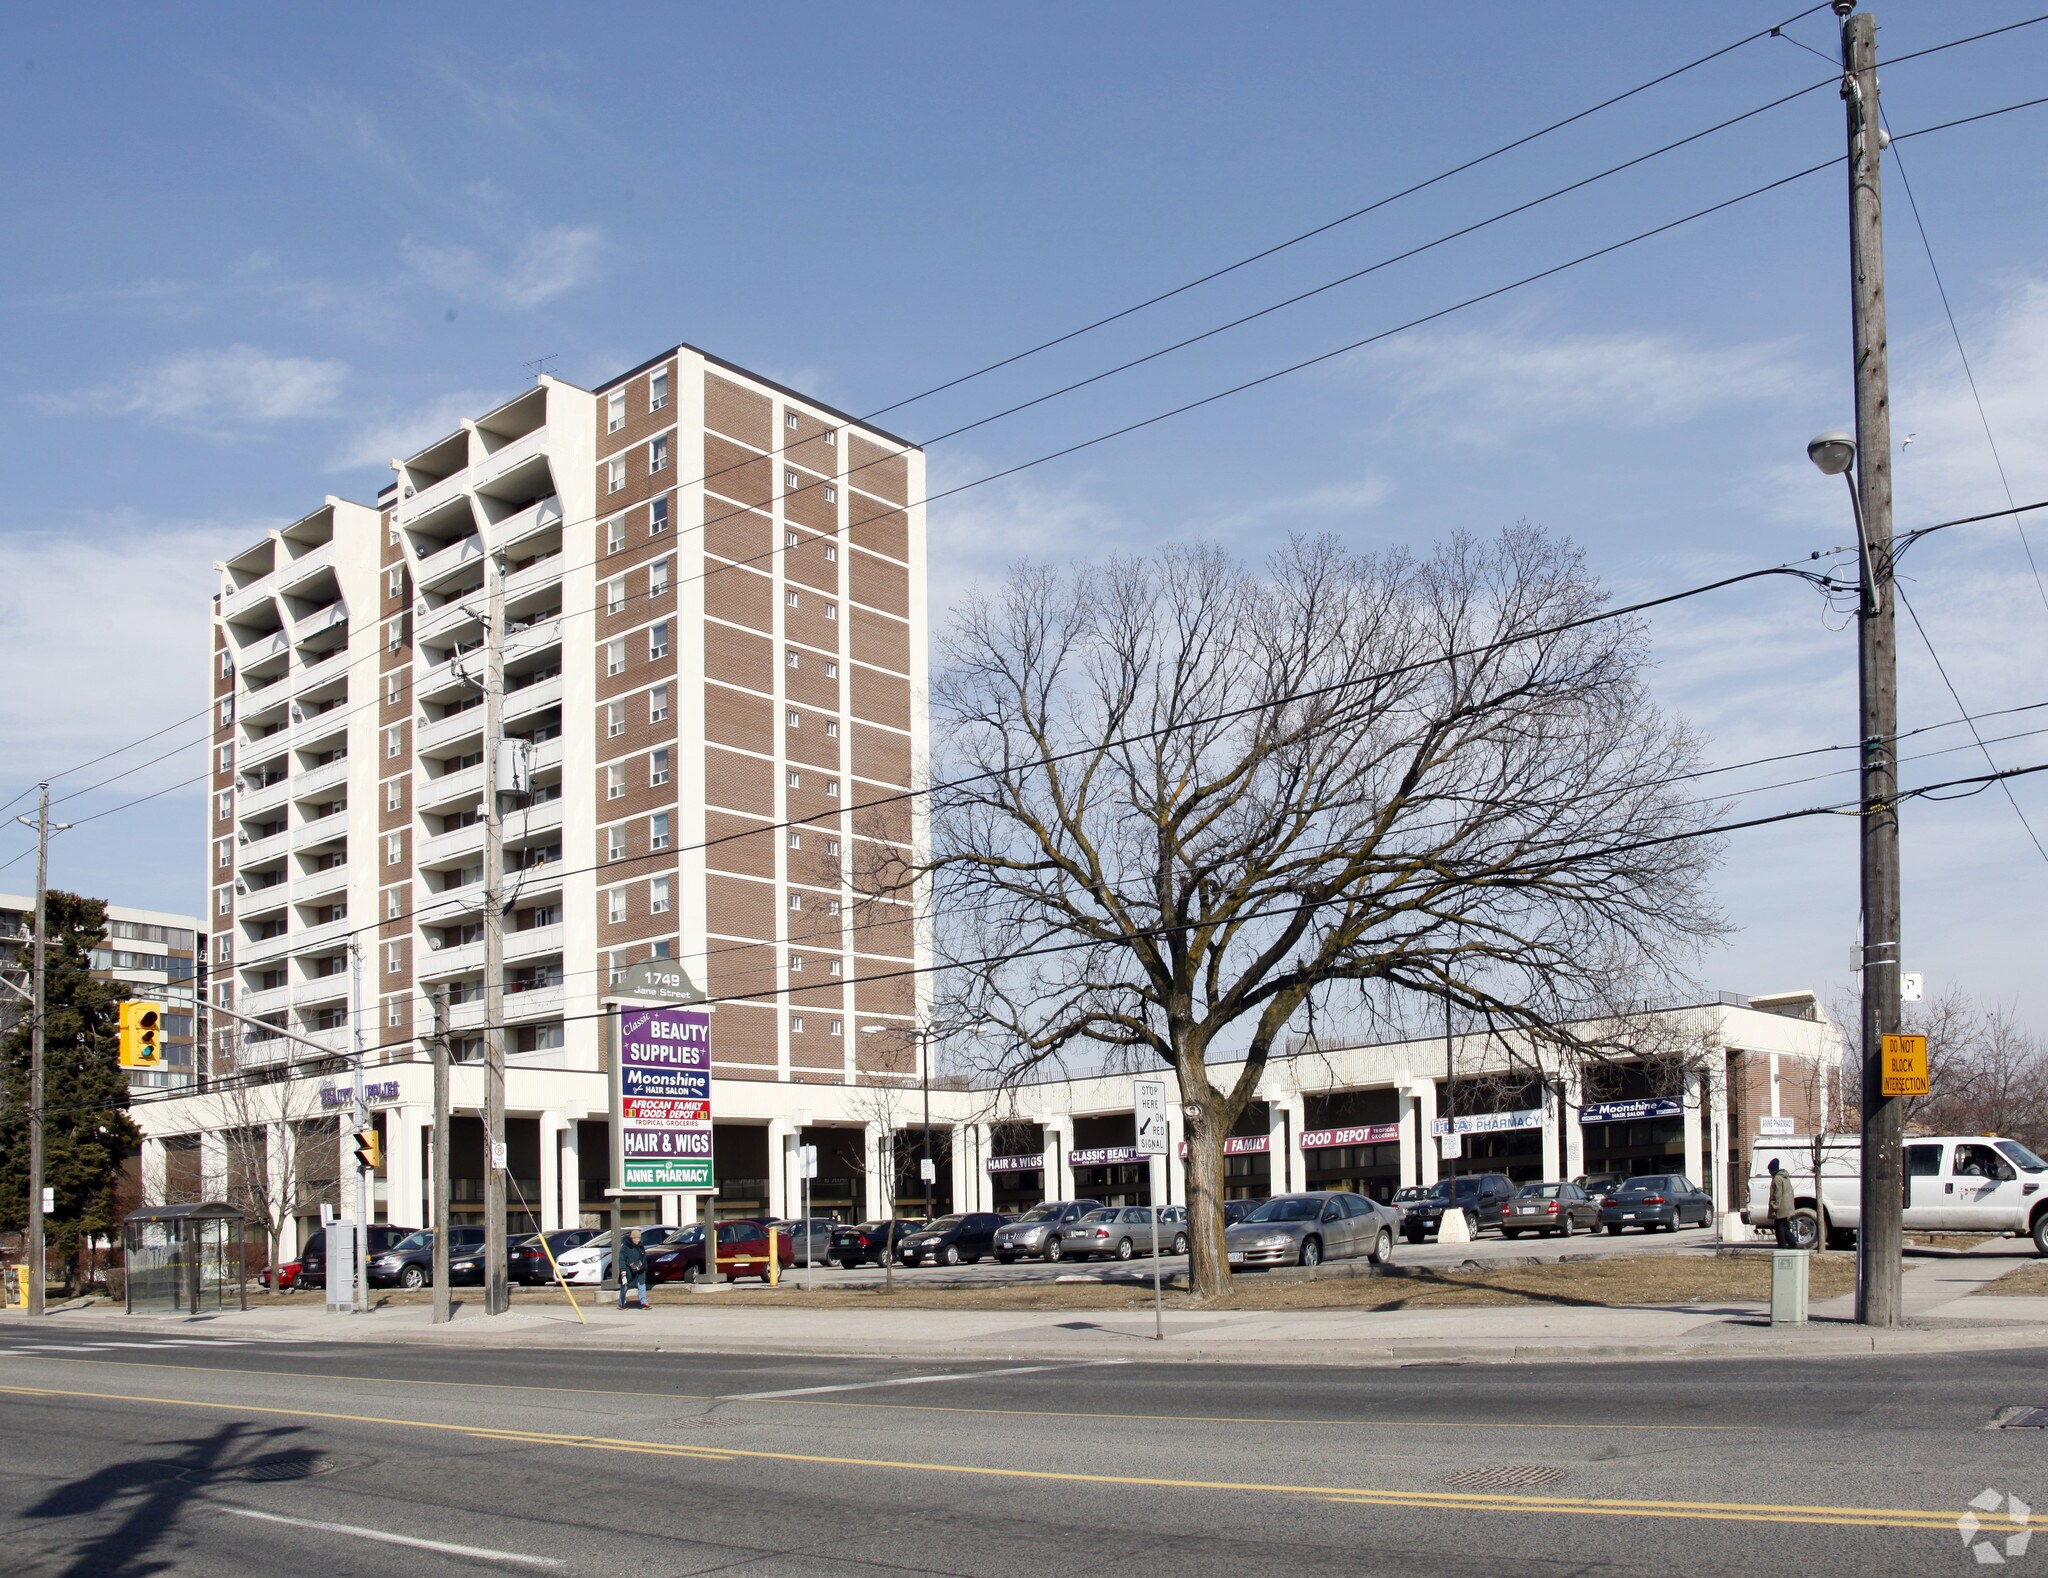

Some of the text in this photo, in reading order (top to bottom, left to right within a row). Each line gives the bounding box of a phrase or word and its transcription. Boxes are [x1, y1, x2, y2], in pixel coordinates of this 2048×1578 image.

[645, 972, 680, 987] 1749
[634, 986, 691, 999] Jane Street
[623, 1012, 650, 1036] Classic
[651, 1021, 708, 1042] BEAUTY
[1889, 1039, 1915, 1053] DO NOT
[630, 1042, 700, 1065] SUPPLIES
[1891, 1058, 1914, 1072] BLOCK
[627, 1070, 706, 1087] Moonshine
[1885, 1077, 1927, 1091] INTERSECTION
[645, 1086, 689, 1095] HAIR SALON
[1141, 1086, 1158, 1095] STOP
[673, 1102, 703, 1110] FAMILY
[1142, 1100, 1159, 1109] HERE
[1599, 1101, 1657, 1114] Moonshine
[639, 1109, 694, 1119] FOODS DEPOT
[1155, 1113, 1164, 1122] ON
[1153, 1126, 1165, 1135] RED
[1476, 1116, 1540, 1131] PHARMACY
[625, 1133, 709, 1153] HAIR & WIGS
[1141, 1139, 1163, 1149] SIGNAL
[1231, 1137, 1268, 1151] FAMILY
[1301, 1128, 1370, 1147] FOOD DEPOT
[1071, 1148, 1139, 1161] CLASSIC BEAUT
[988, 1156, 1043, 1170] HAIR & WIGS
[626, 1169, 708, 1182] ANNE PHARMACY
